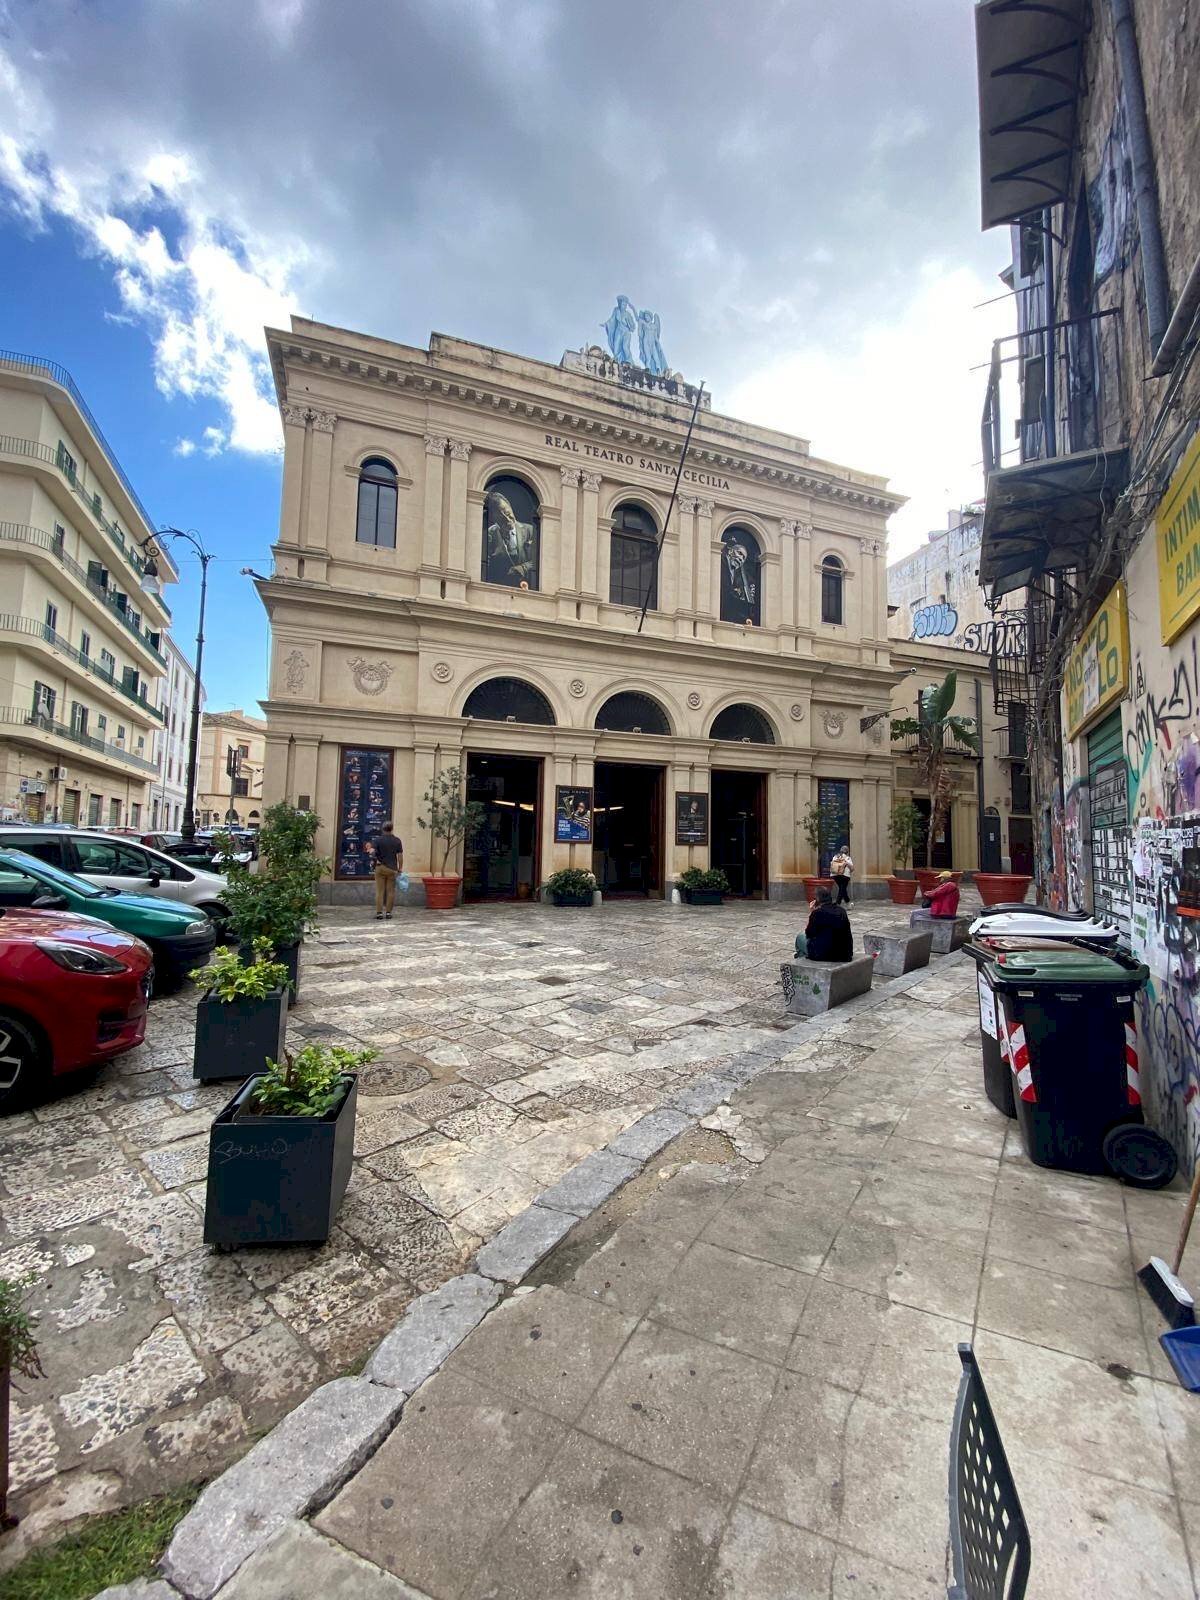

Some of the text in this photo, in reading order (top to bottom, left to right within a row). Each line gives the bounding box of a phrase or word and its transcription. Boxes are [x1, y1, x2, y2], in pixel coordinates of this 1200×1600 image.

[545, 434, 730, 490] REAL TEATRO SANTA CECILIA
[1164, 482, 1200, 563] INTIM
